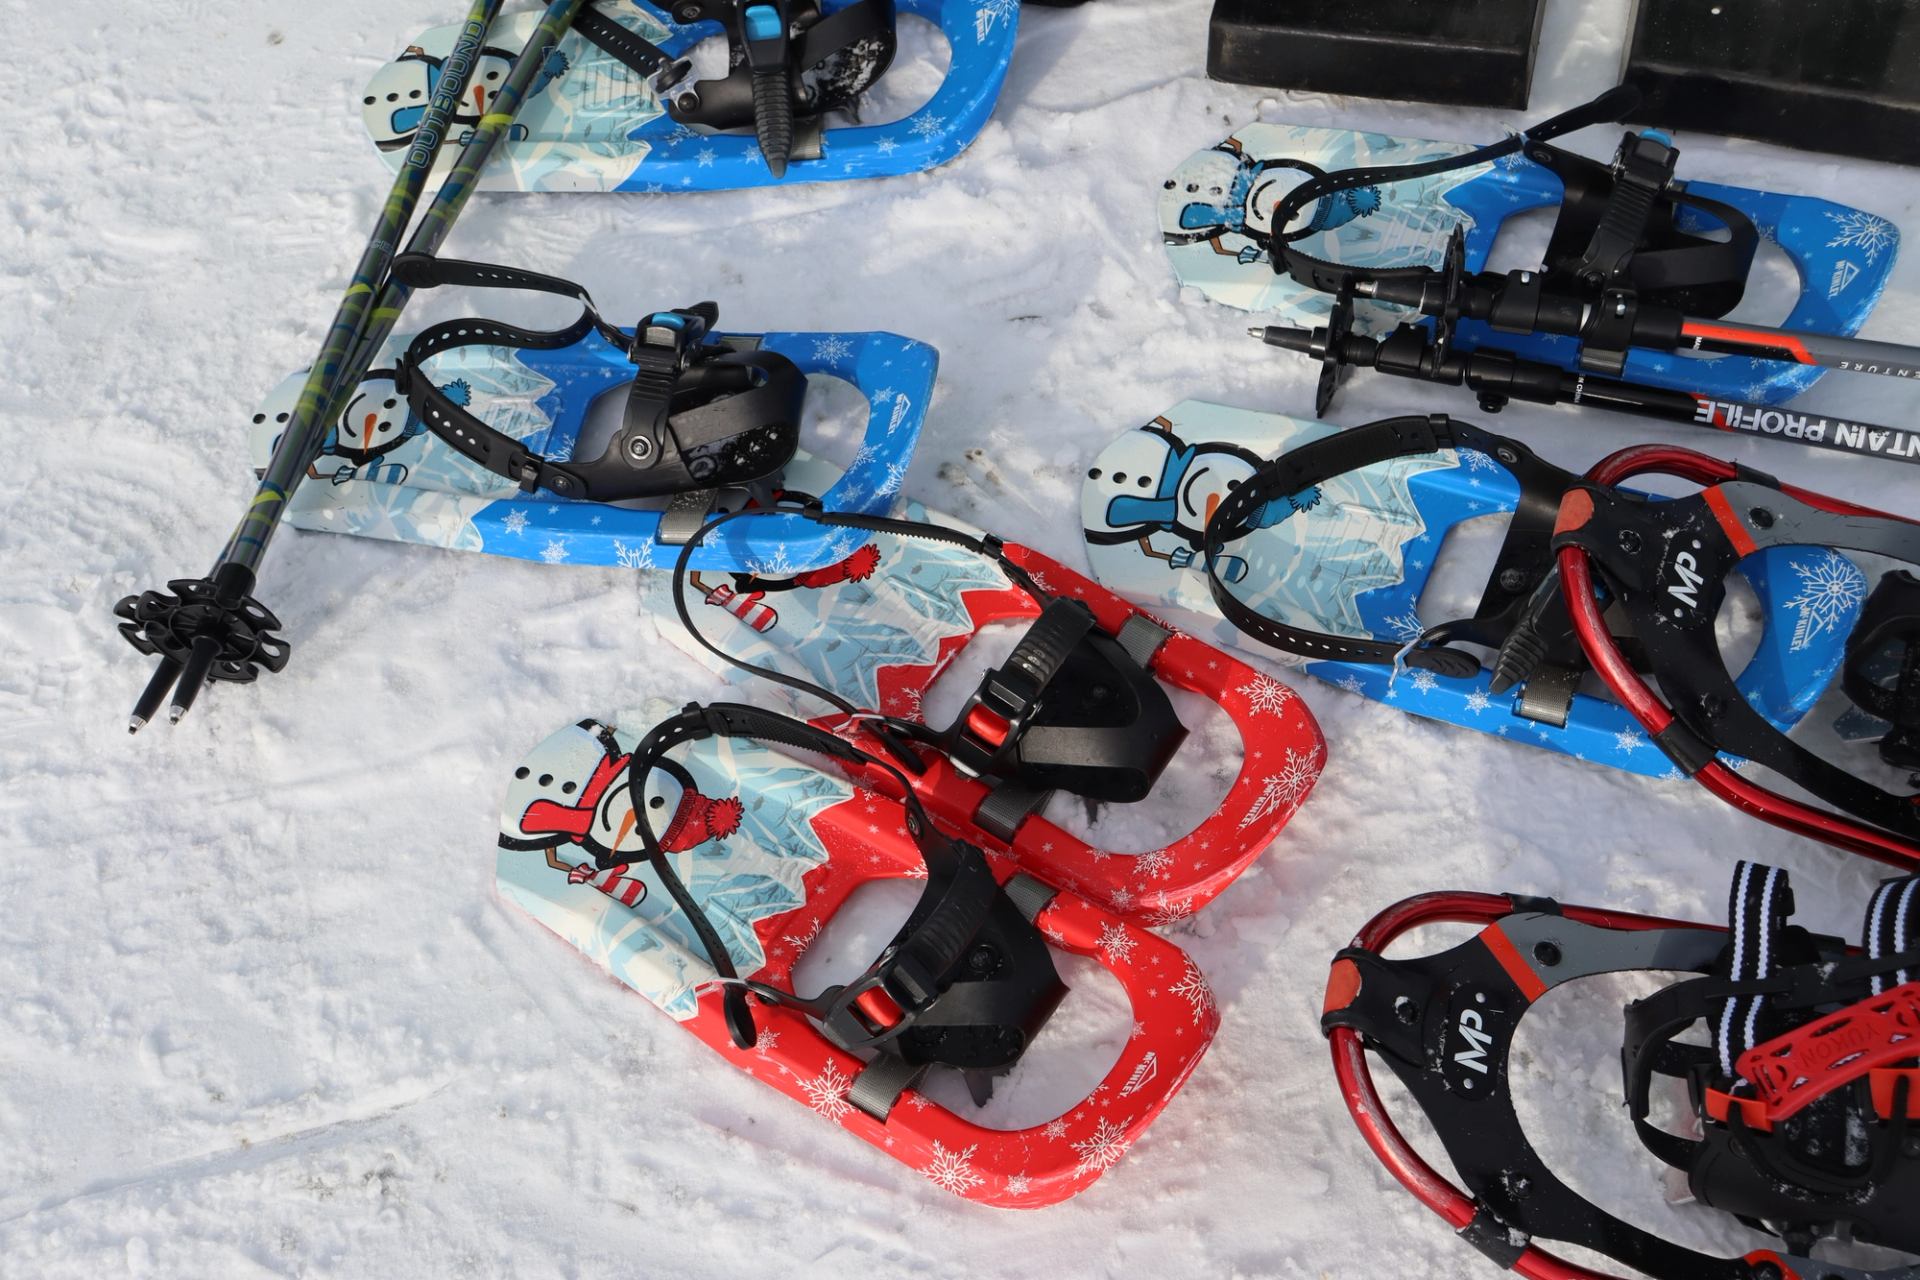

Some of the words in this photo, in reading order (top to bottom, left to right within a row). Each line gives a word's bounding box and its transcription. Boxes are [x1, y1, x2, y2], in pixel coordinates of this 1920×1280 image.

[407, 20, 487, 169] OUTBOUND
[1840, 361, 1920, 378] ENTURE
[1694, 399, 1827, 443] PROFILE
[1834, 423, 1920, 458] NTAIN
[1668, 551, 1704, 608] MP
[1454, 1008, 1492, 1075] MP
[1798, 1022, 1880, 1071] YUKON
